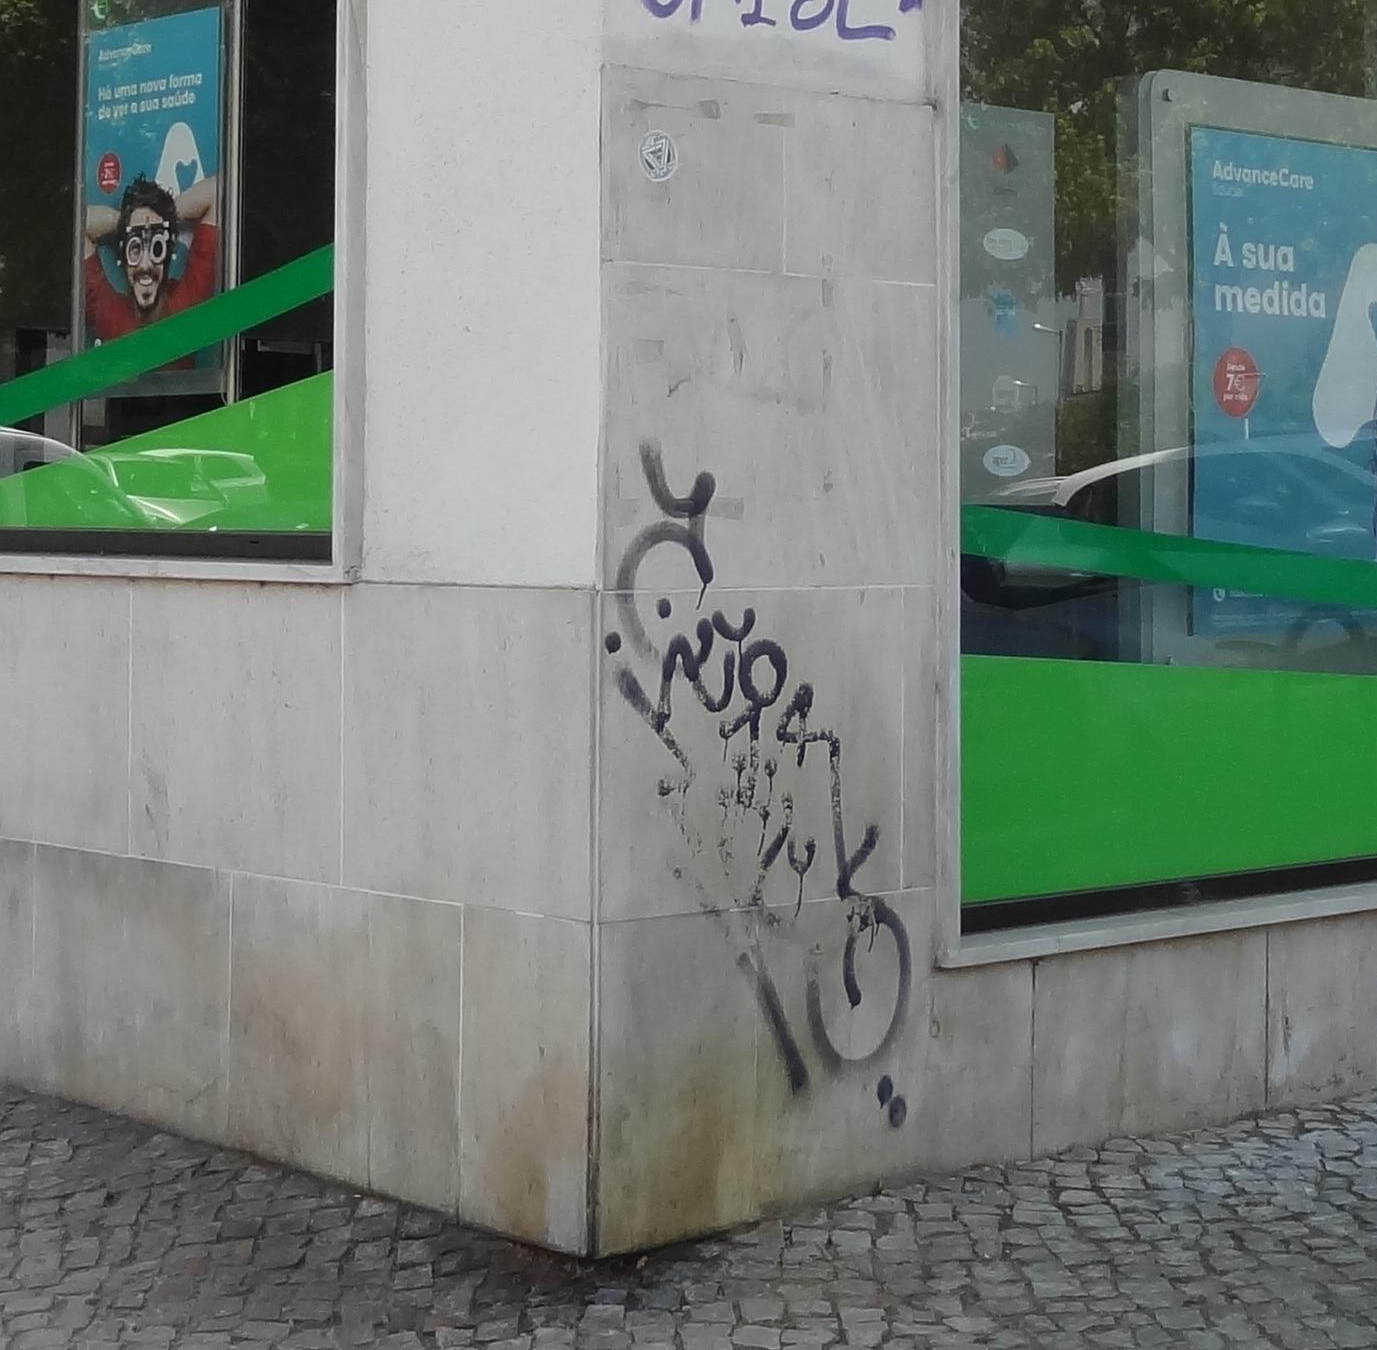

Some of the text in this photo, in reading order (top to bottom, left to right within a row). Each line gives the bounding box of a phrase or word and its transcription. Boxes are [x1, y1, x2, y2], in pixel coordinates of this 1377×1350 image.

[113, 83, 138, 98] uma
[139, 78, 168, 94] nova
[168, 72, 203, 89] forma
[130, 101, 138, 114] a
[139, 97, 160, 112] sua
[161, 89, 197, 109] saúde
[1212, 159, 1315, 191] AdvanceCare
[1241, 241, 1295, 273] sua
[1214, 280, 1327, 319] medida
